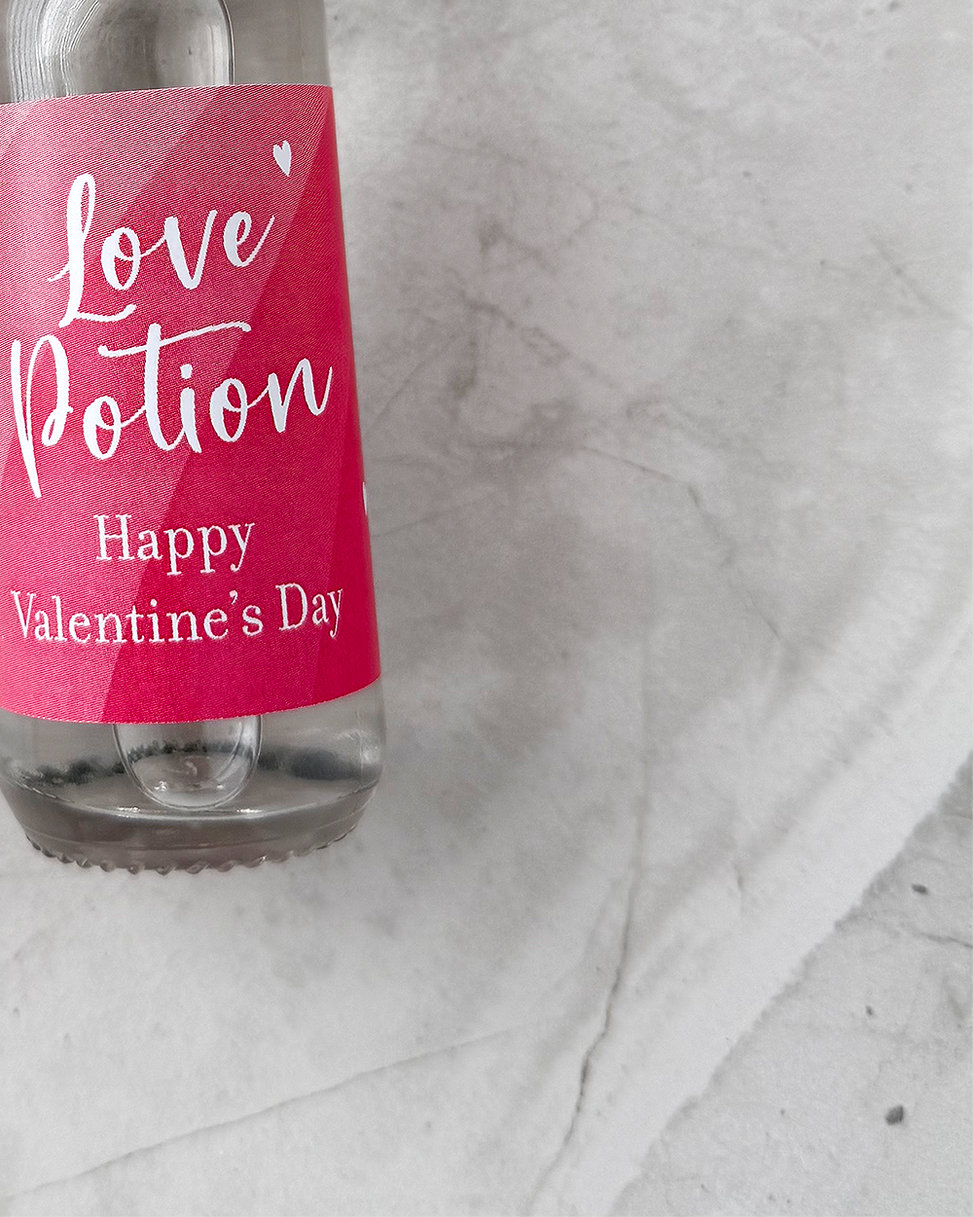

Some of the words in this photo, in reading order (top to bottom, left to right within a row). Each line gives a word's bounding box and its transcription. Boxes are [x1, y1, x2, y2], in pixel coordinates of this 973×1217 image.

[46, 172, 276, 329] Love
[10, 320, 334, 500] Potion
[92, 513, 256, 577] Happy
[10, 589, 264, 644] Valentine’s
[275, 581, 345, 639] Day
